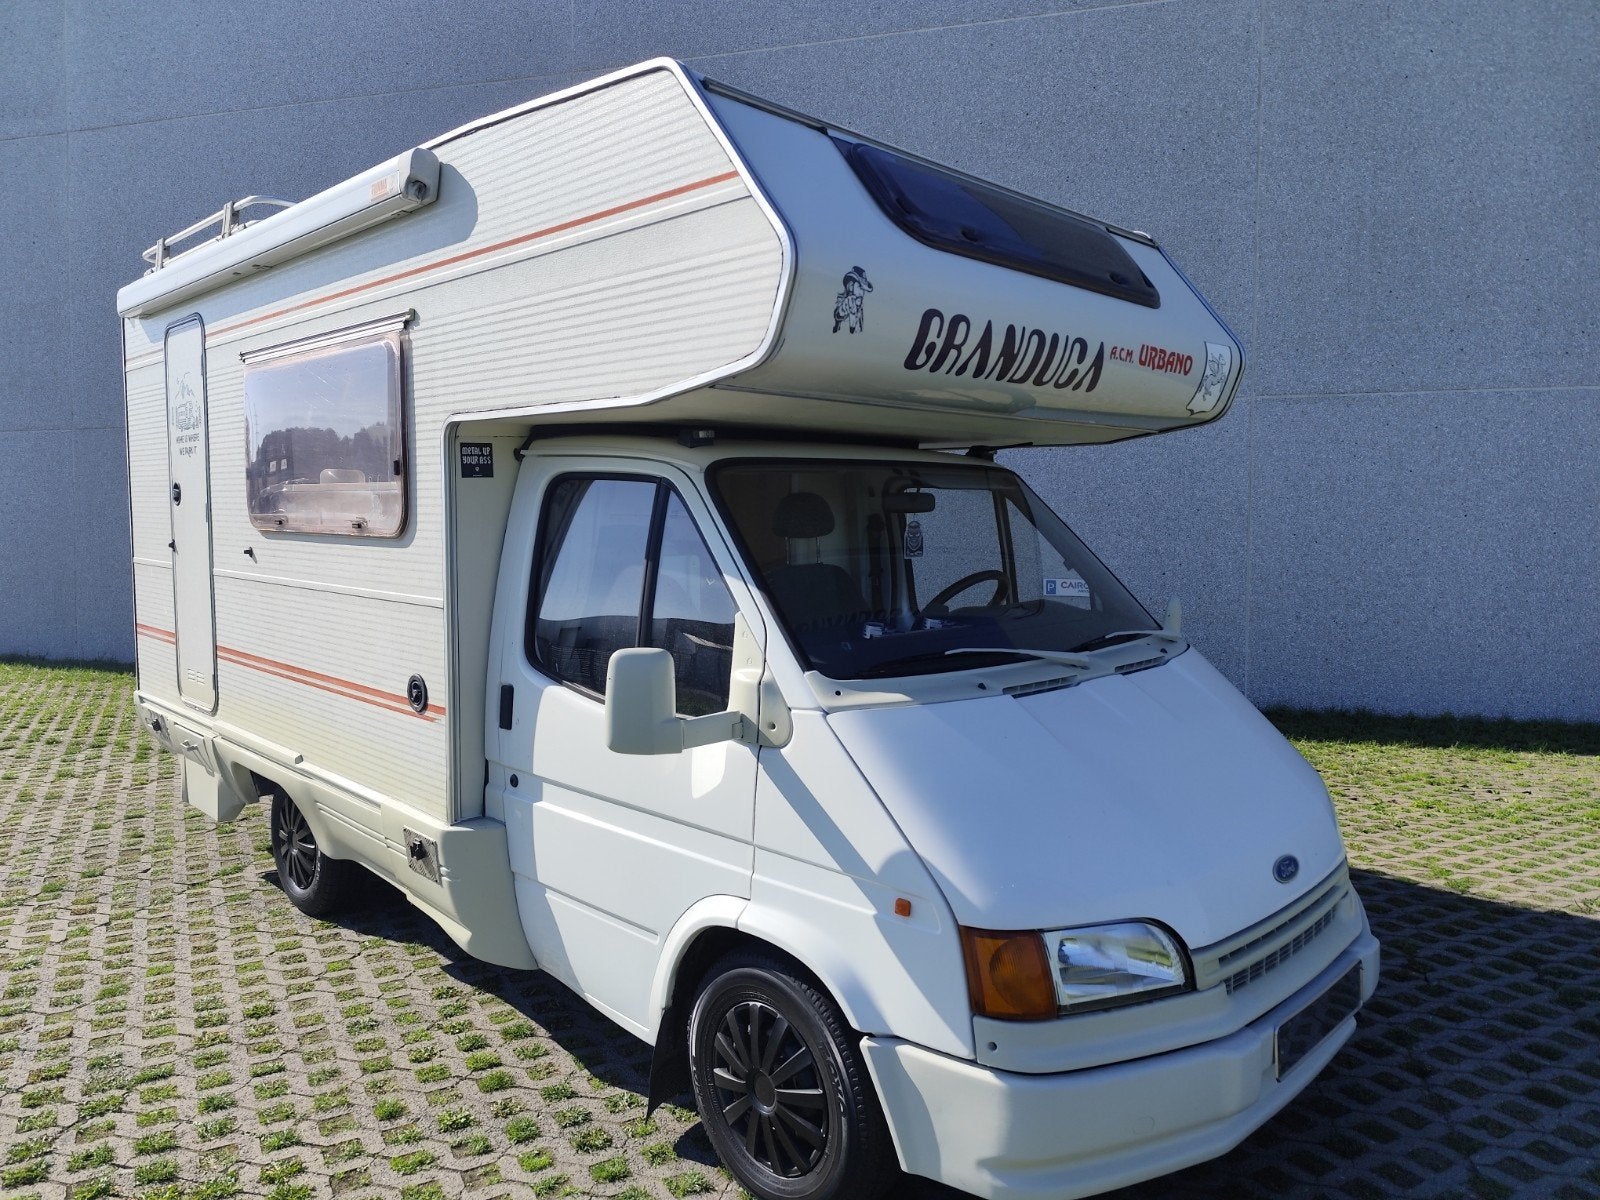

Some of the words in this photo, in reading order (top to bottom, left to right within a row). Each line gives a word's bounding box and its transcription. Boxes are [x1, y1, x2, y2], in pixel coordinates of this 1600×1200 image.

[903, 308, 1105, 393] GRANDUCA
[1110, 346, 1134, 364] A.C.M.
[1138, 344, 1194, 376] URBANO
[462, 446, 482, 455] METAL
[482, 446, 491, 455] UP
[462, 455, 478, 465] YOUR
[479, 455, 492, 465] ASS
[1277, 858, 1296, 879] Ford
